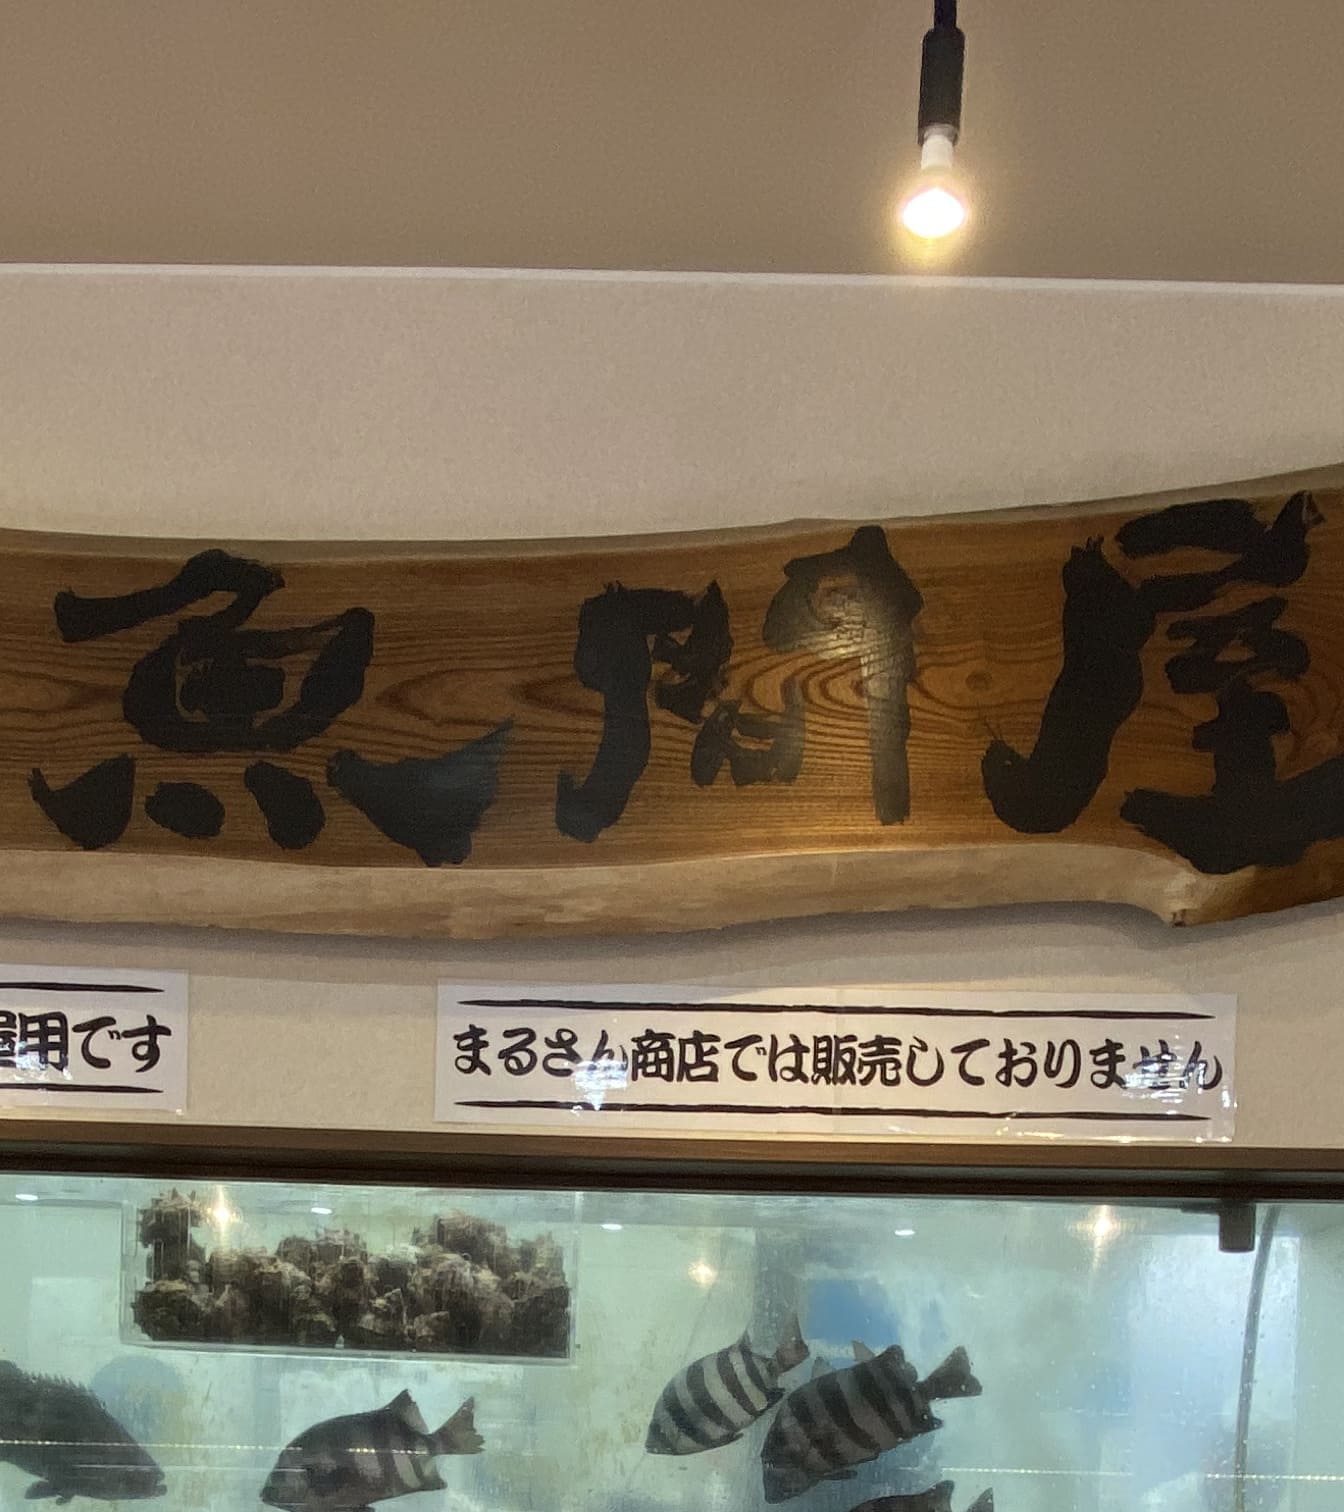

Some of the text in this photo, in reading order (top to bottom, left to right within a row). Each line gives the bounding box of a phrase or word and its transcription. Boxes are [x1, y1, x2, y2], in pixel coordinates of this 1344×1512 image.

[453, 1026, 1223, 1092] まるさん商店では販売しておりません
